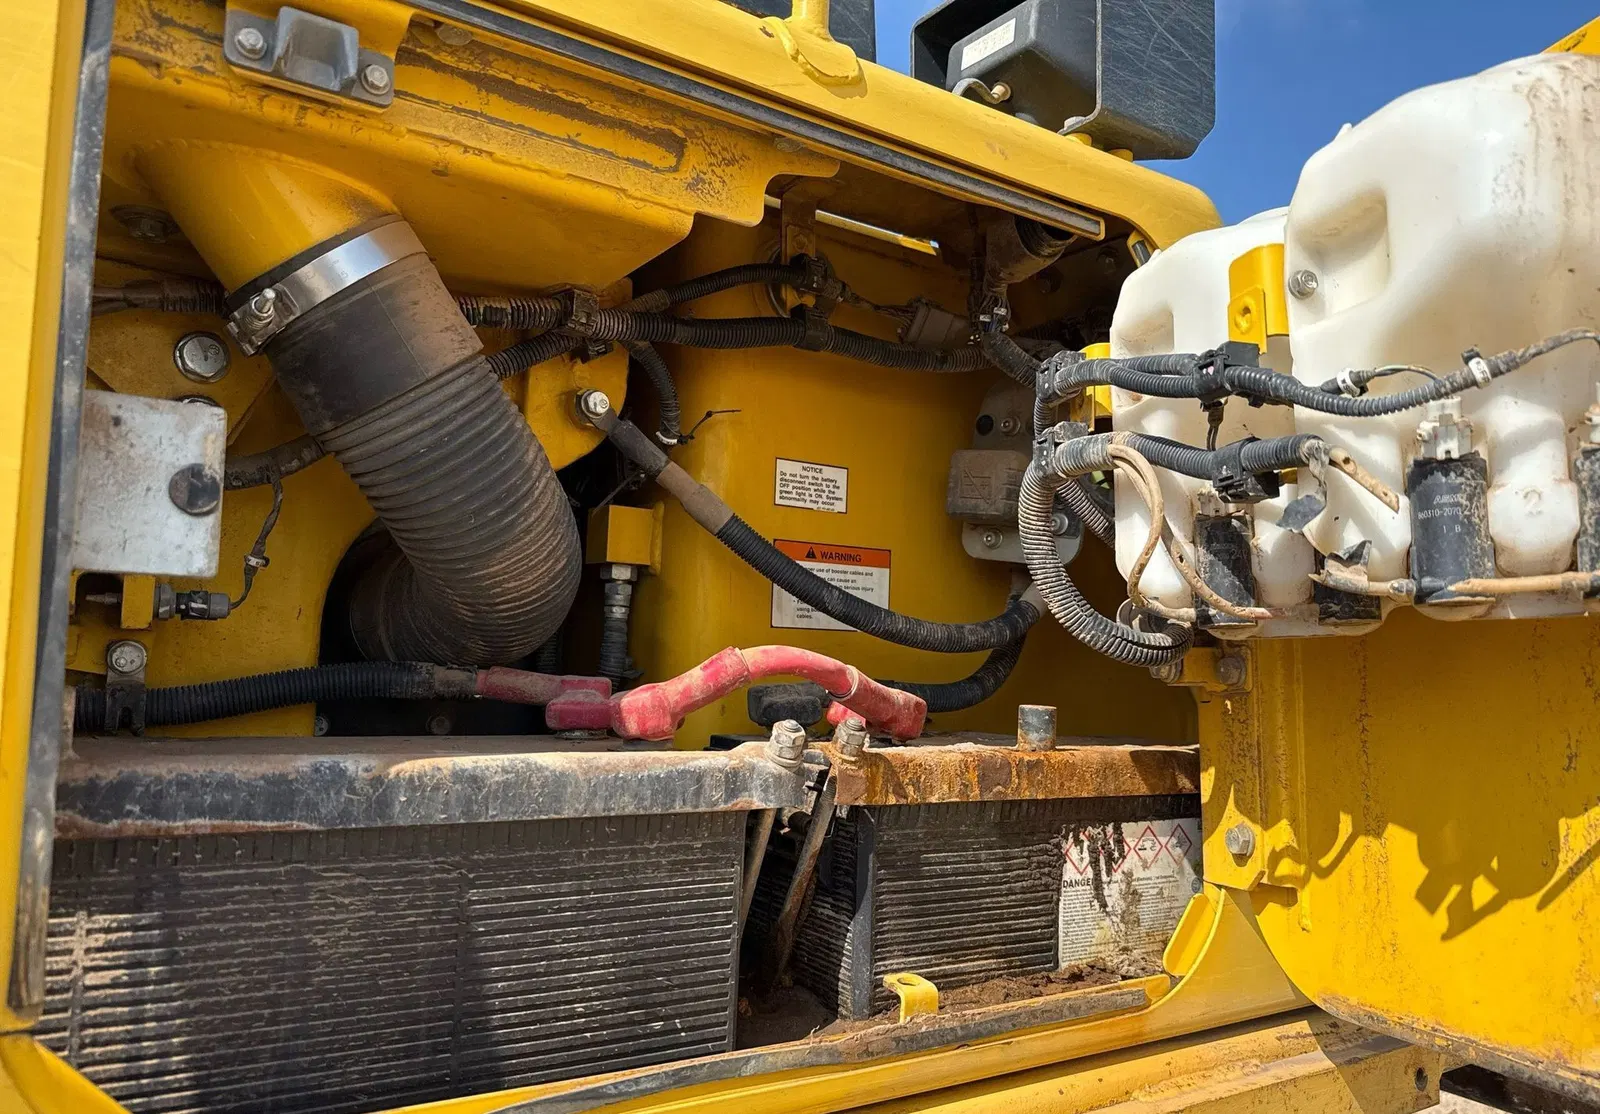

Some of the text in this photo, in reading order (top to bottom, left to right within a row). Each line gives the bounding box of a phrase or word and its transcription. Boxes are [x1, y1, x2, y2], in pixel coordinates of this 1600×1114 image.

[802, 466, 823, 474] NOTICE
[779, 495, 807, 503] abnormality
[820, 550, 862, 562] WARNING
